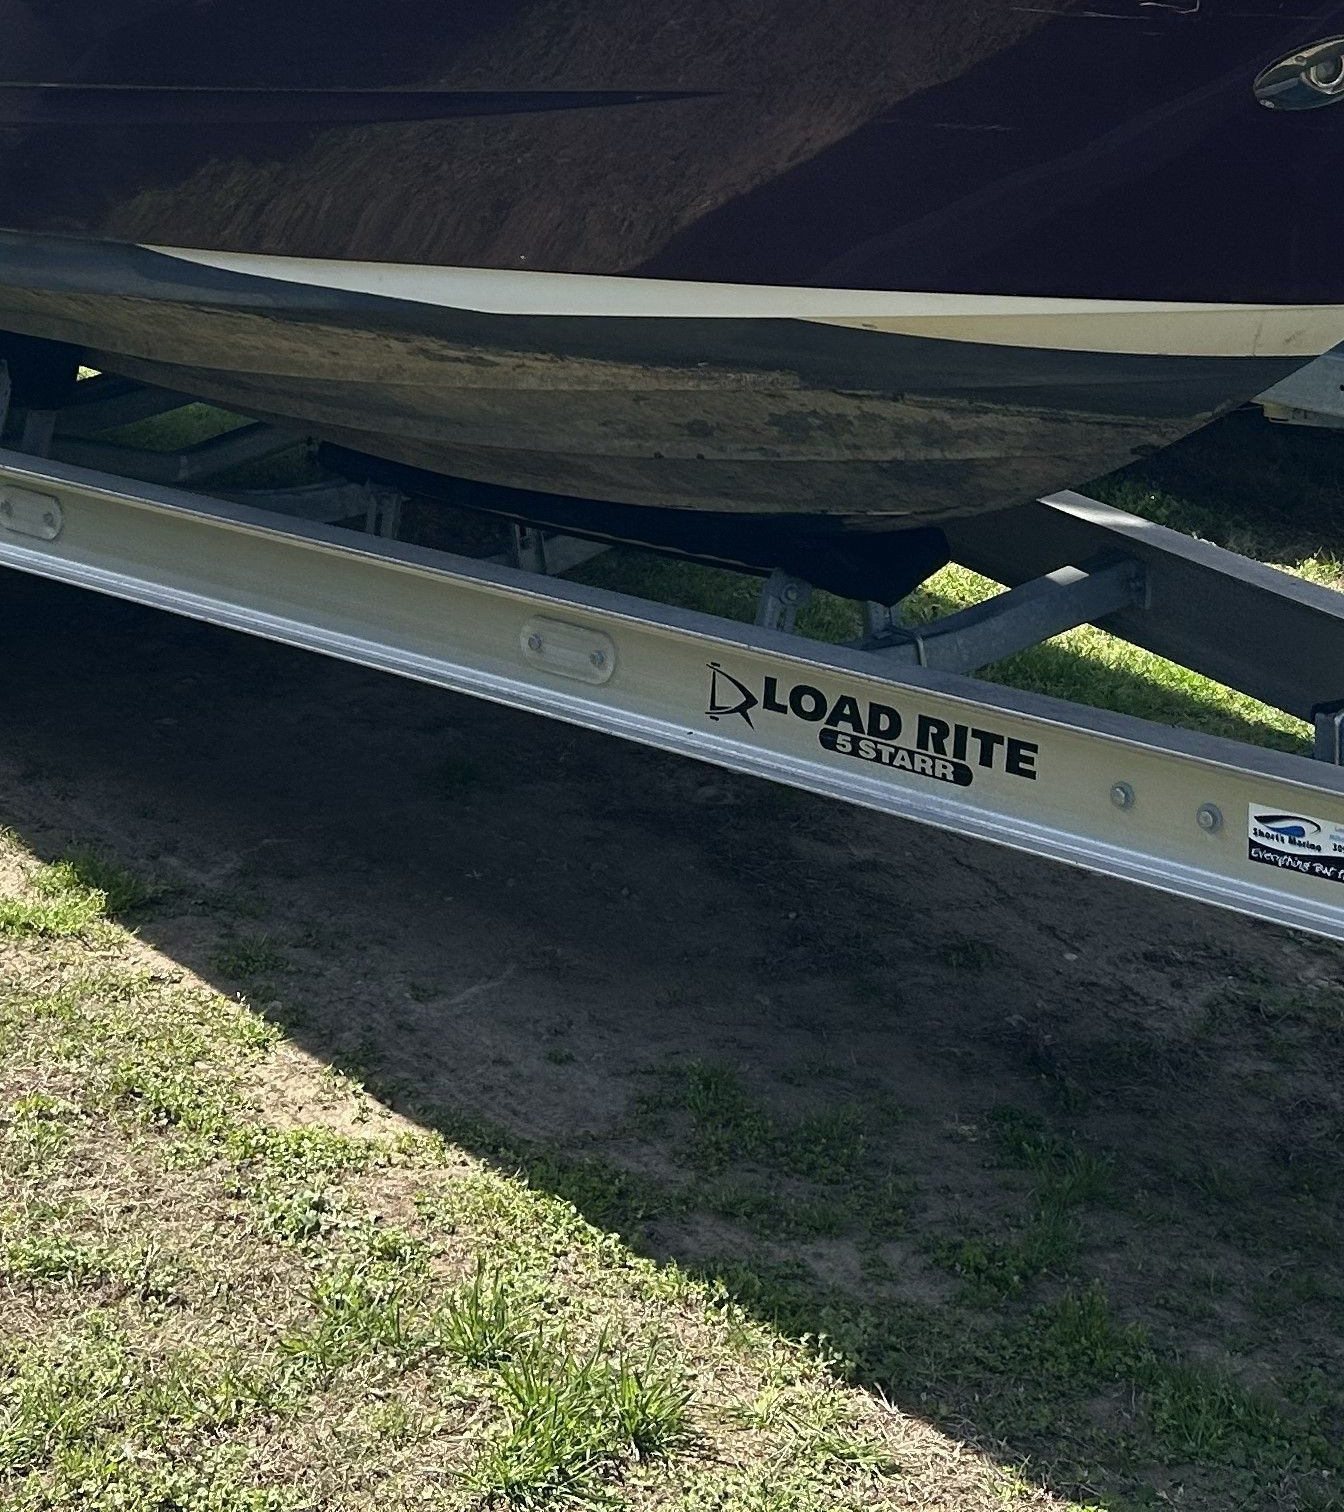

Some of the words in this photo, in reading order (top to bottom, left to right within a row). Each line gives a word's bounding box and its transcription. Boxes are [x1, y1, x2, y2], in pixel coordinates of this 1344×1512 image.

[762, 675, 903, 742] LOAD
[916, 713, 1039, 781] RITE
[835, 733, 853, 754] 5
[858, 740, 955, 781] STARR
[1288, 835, 1322, 852] Marine
